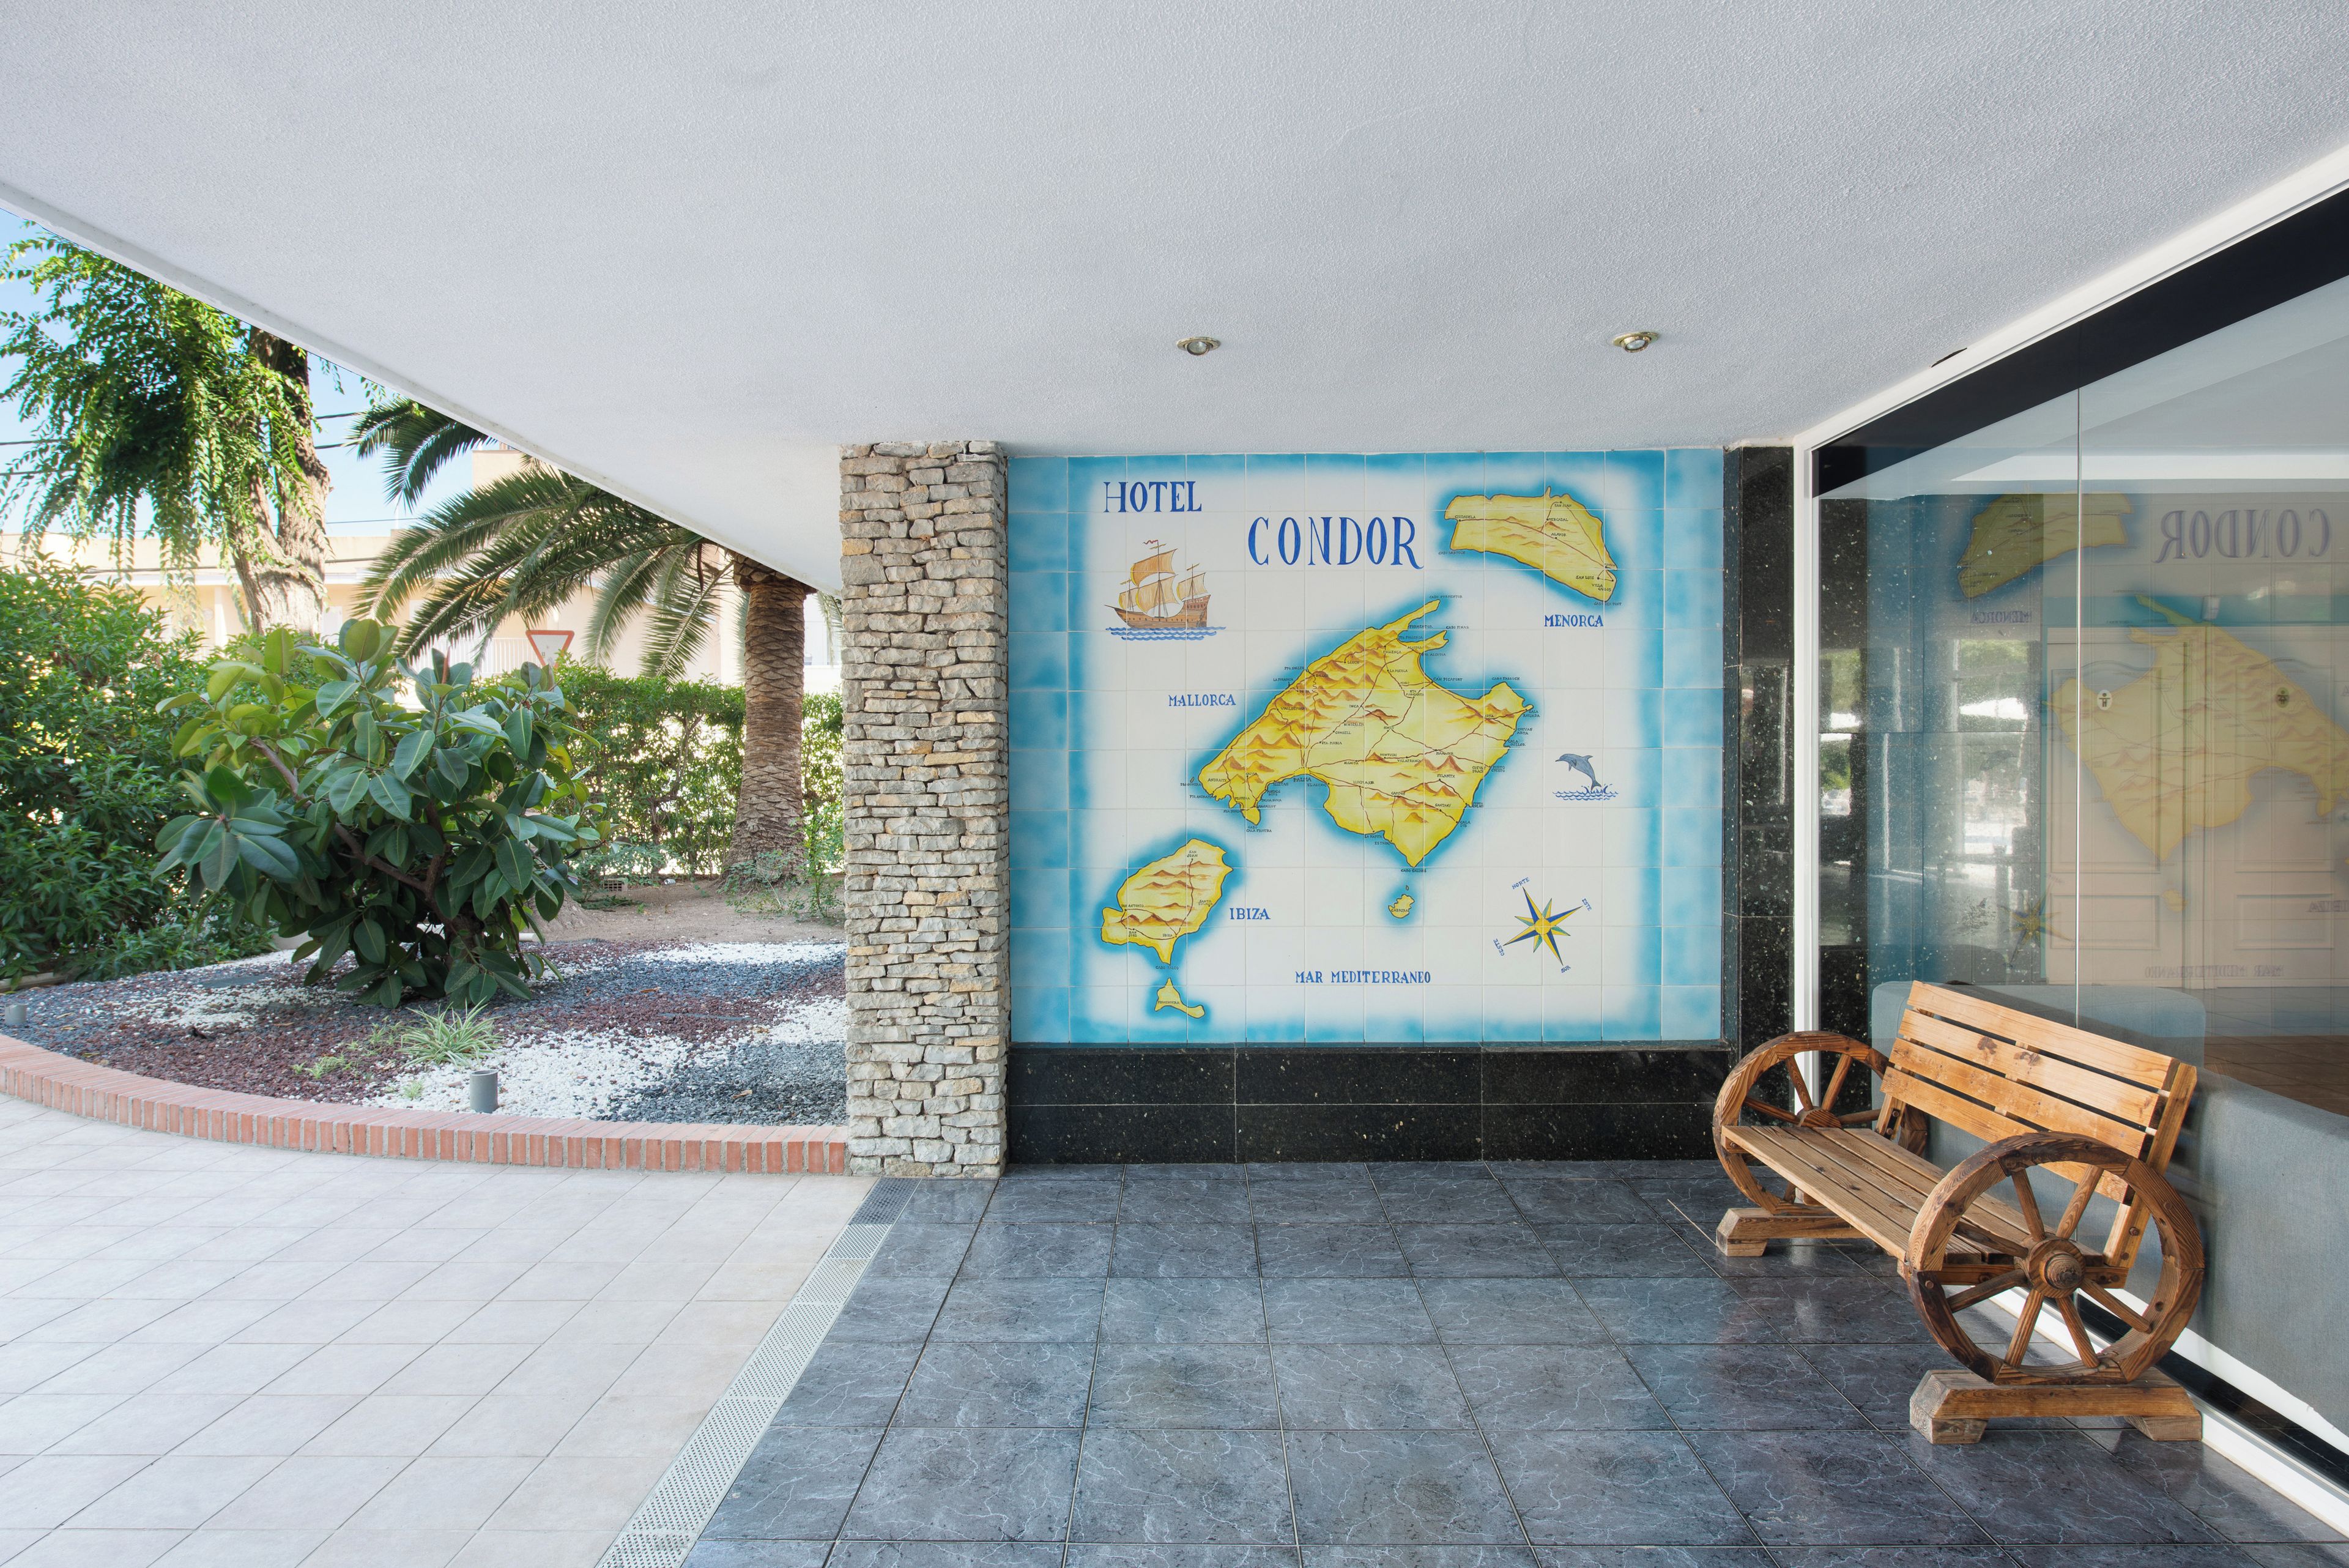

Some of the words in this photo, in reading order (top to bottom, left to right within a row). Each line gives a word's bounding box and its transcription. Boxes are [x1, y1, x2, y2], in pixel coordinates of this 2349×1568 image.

[1104, 481, 1202, 513] HOTEL
[1248, 516, 1424, 570] CONDOR
[1545, 615, 1603, 627] MENORCA
[1168, 694, 1236, 706] MALLORCA
[1512, 877, 1529, 890] NORTE
[1582, 898, 1592, 911] ESTE
[1230, 908, 1271, 920] IBIZA
[1296, 972, 1323, 983] MAR
[1331, 971, 1431, 984] MEDITERRANEO
